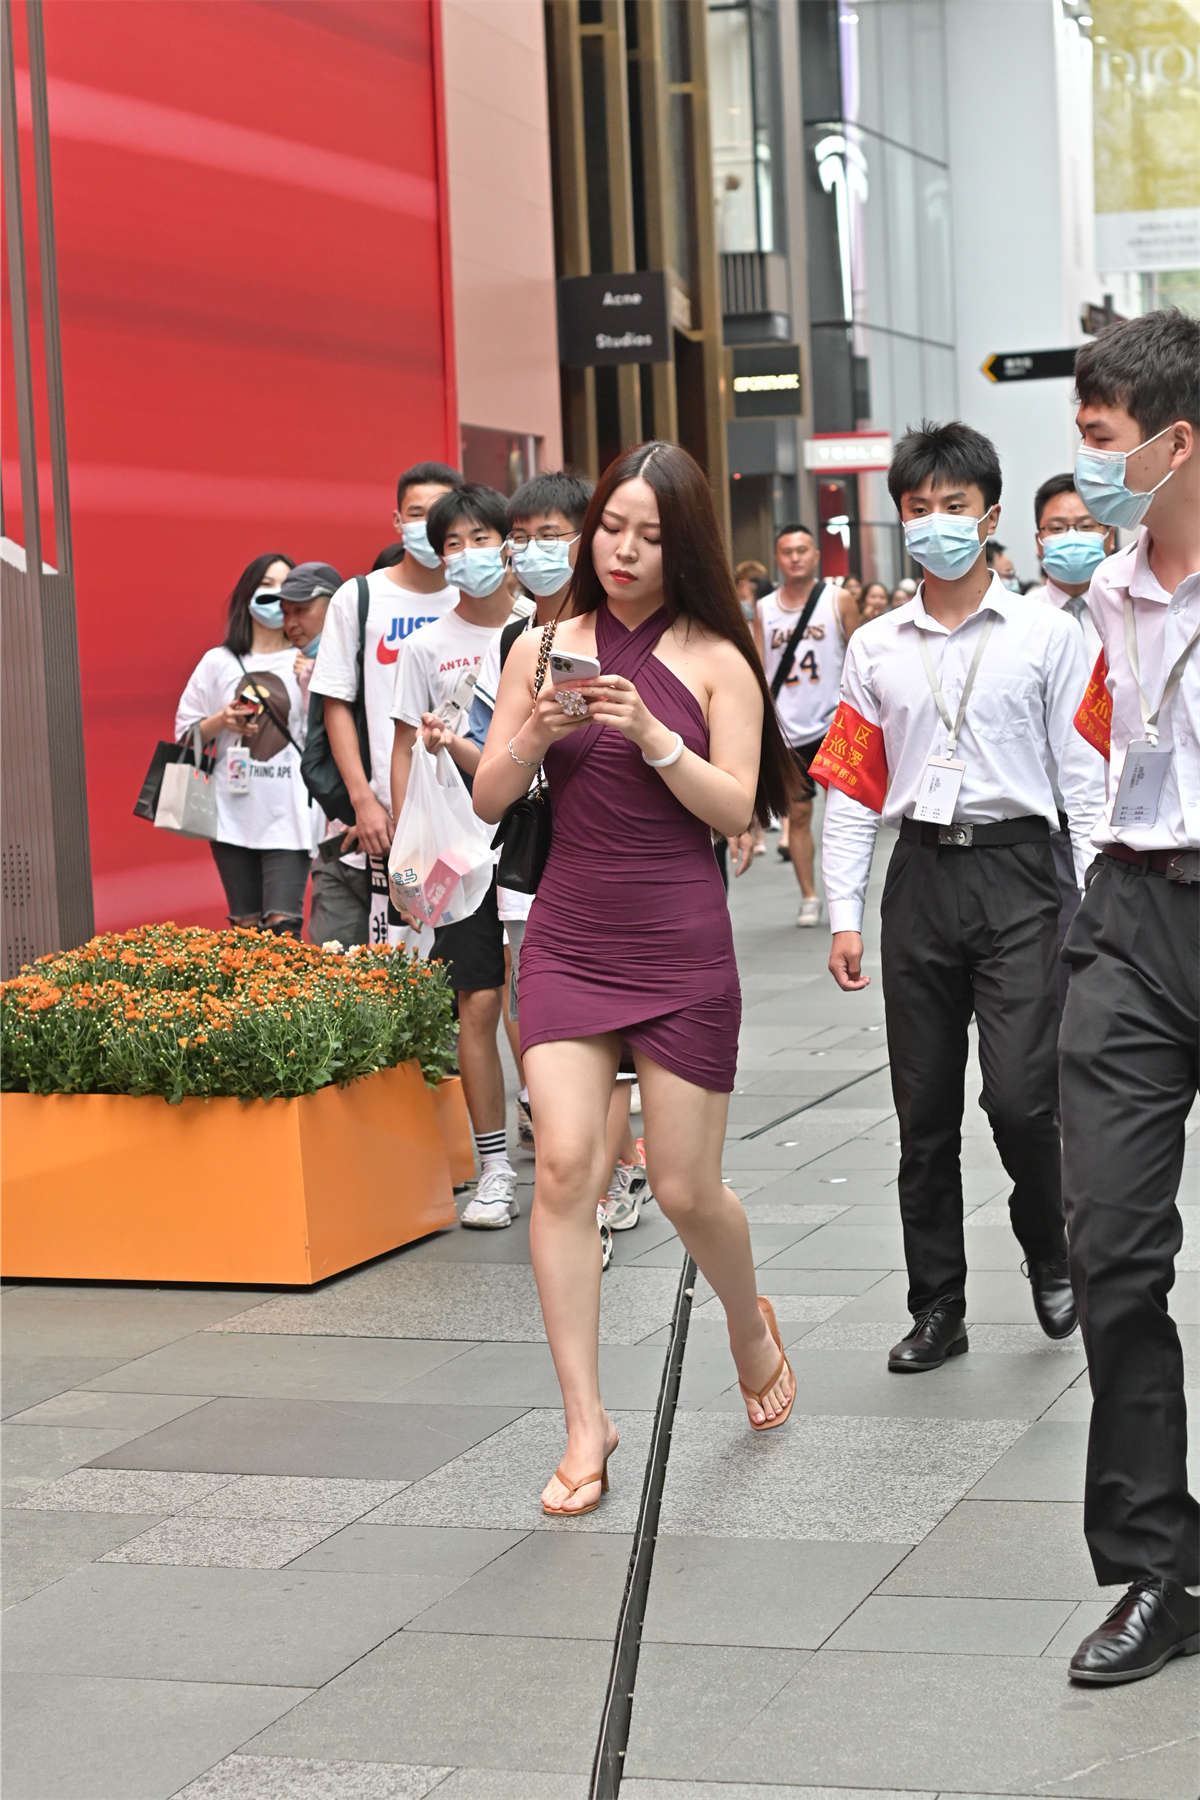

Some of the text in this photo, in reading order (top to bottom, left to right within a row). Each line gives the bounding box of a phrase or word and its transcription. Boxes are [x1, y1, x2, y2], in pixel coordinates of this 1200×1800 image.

[1099, 46, 1200, 92] DIO
[602, 291, 642, 306] Acne
[595, 331, 652, 349] Studios
[439, 657, 470, 673] ANTA
[821, 731, 863, 771] 巡逻
[277, 766, 291, 778] APE
